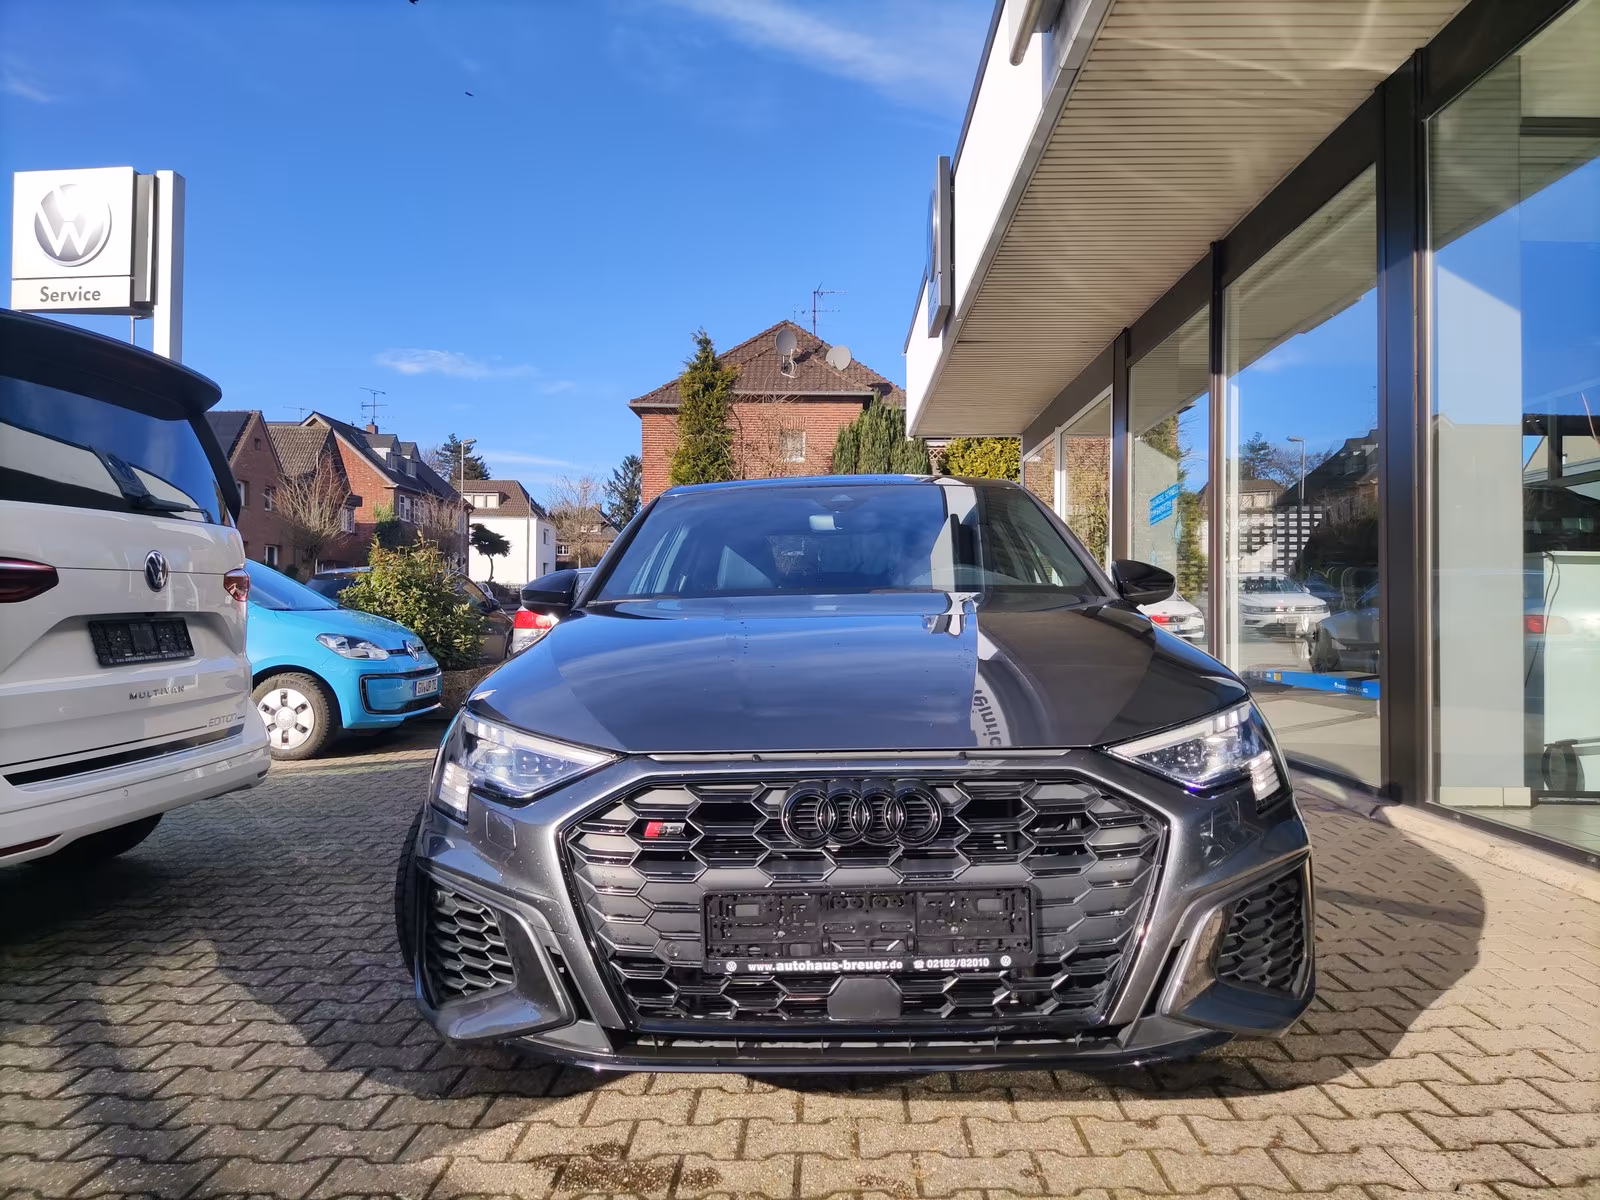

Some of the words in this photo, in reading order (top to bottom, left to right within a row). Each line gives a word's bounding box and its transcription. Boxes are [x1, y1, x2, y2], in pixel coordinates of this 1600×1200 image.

[39, 286, 102, 303] Service
[128, 685, 185, 700] MULTIVAN
[654, 825, 683, 836] S3
[747, 958, 904, 973] www.autohaus-breuer.de
[925, 957, 991, 970] 02182/82010
